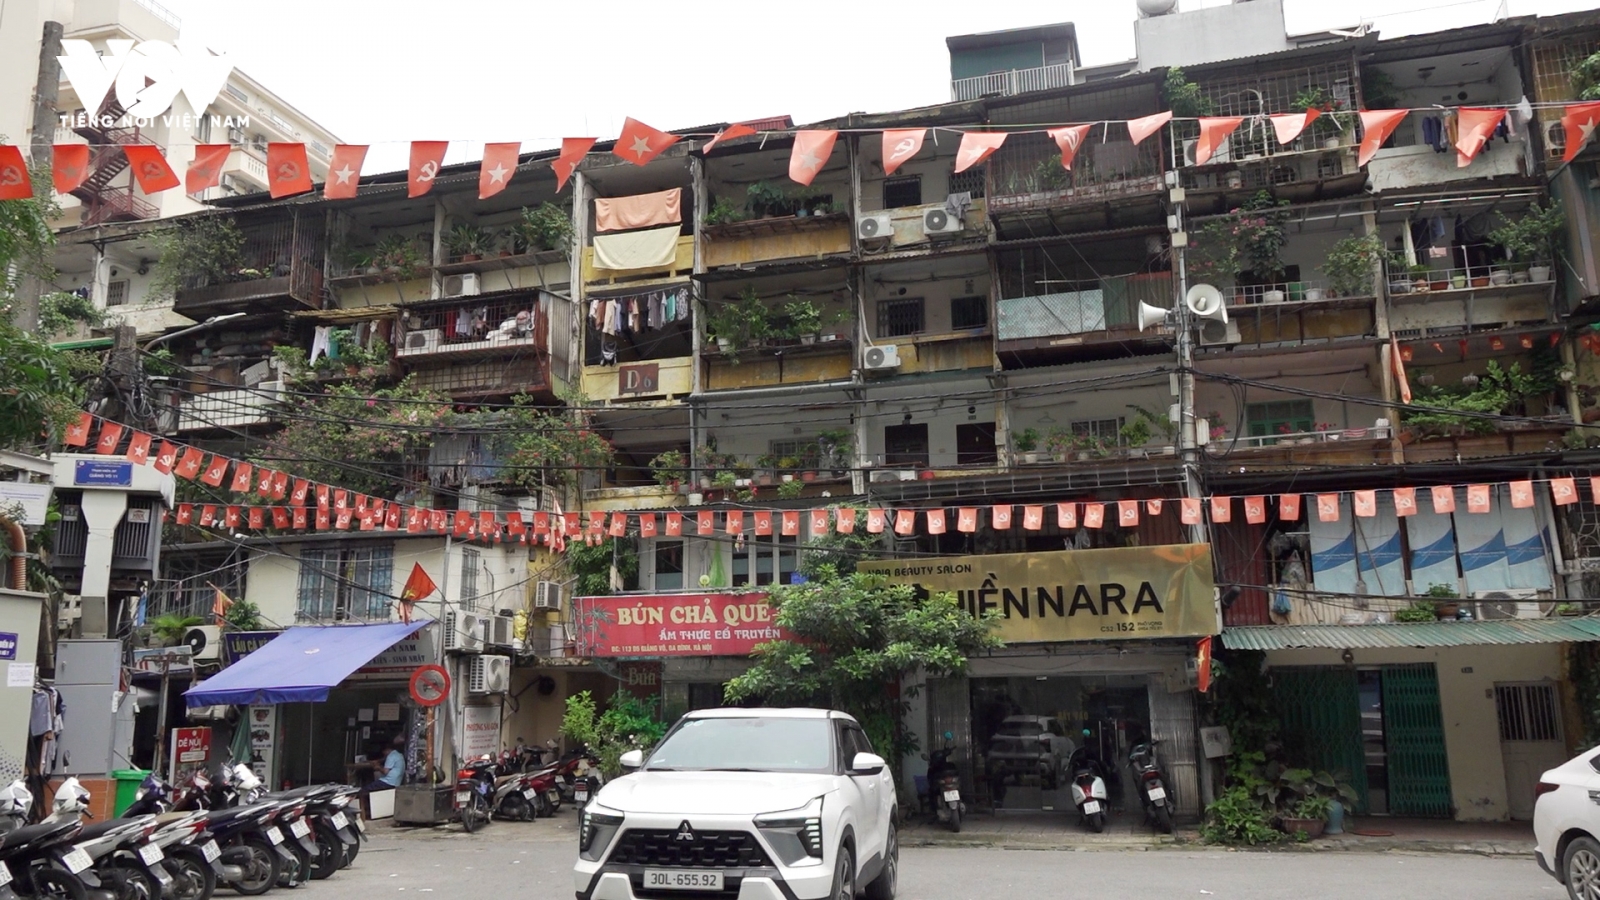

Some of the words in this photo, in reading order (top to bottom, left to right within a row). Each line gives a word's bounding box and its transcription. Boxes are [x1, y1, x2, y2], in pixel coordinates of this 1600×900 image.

[895, 566, 933, 577] BEAUTY
[937, 564, 972, 574] SALON
[617, 602, 664, 625] BÚN
[670, 598, 718, 625] CHẢ
[1116, 622, 1135, 632] 152
[680, 628, 711, 641] THỰC
[734, 626, 781, 640] TRUYỀN
[231, 635, 246, 653] LẨU
[399, 644, 417, 652] NAM
[392, 655, 407, 663] SINH
[408, 653, 425, 663] NHẬT
[178, 737, 188, 748] DÊ
